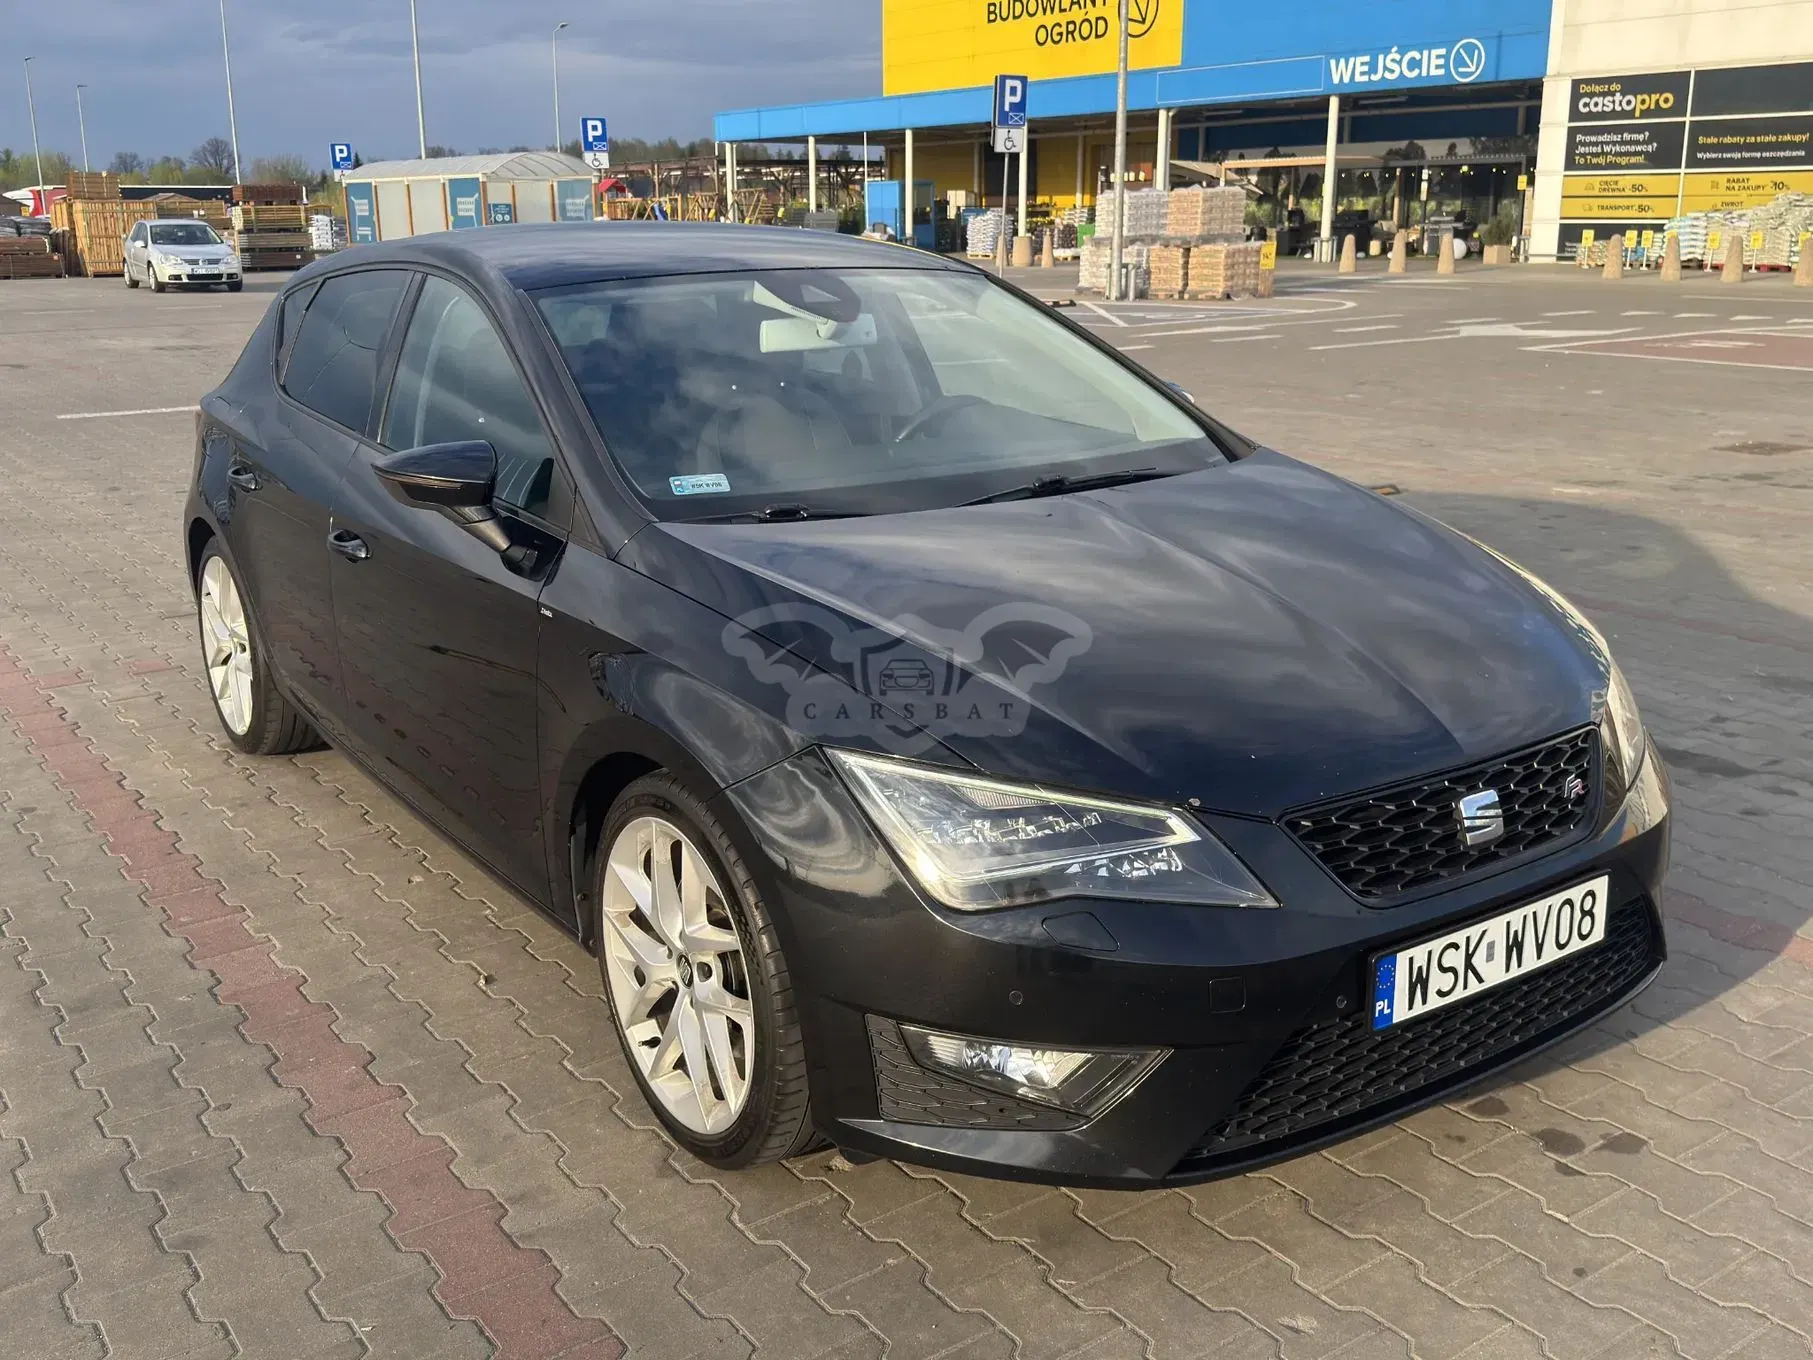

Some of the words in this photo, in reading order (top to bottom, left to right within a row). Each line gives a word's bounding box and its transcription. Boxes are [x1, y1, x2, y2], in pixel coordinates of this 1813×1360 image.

[1035, 11, 1108, 46] OGRÓD
[1329, 46, 1447, 84] WEJŚCIE
[1004, 79, 1022, 112] P
[1580, 84, 1608, 94] Dołącz
[1610, 82, 1621, 91] do
[1578, 92, 1674, 117] castopro
[587, 120, 603, 142] P
[1576, 133, 1622, 143] Prowadzisz
[1623, 131, 1650, 142] firmę?
[1719, 135, 1745, 145] rabaty
[1778, 132, 1810, 143] zakupy!
[335, 145, 348, 162] P
[1575, 144, 1602, 154] Jesteś
[1603, 142, 1657, 155] Wykonawcą?
[1575, 156, 1585, 164] To
[1586, 155, 1606, 166] Twój
[1607, 154, 1645, 165] Program!
[1407, 928, 1489, 1012] WSK
[1504, 889, 1597, 975] WV08
[1375, 999, 1392, 1018] PL
